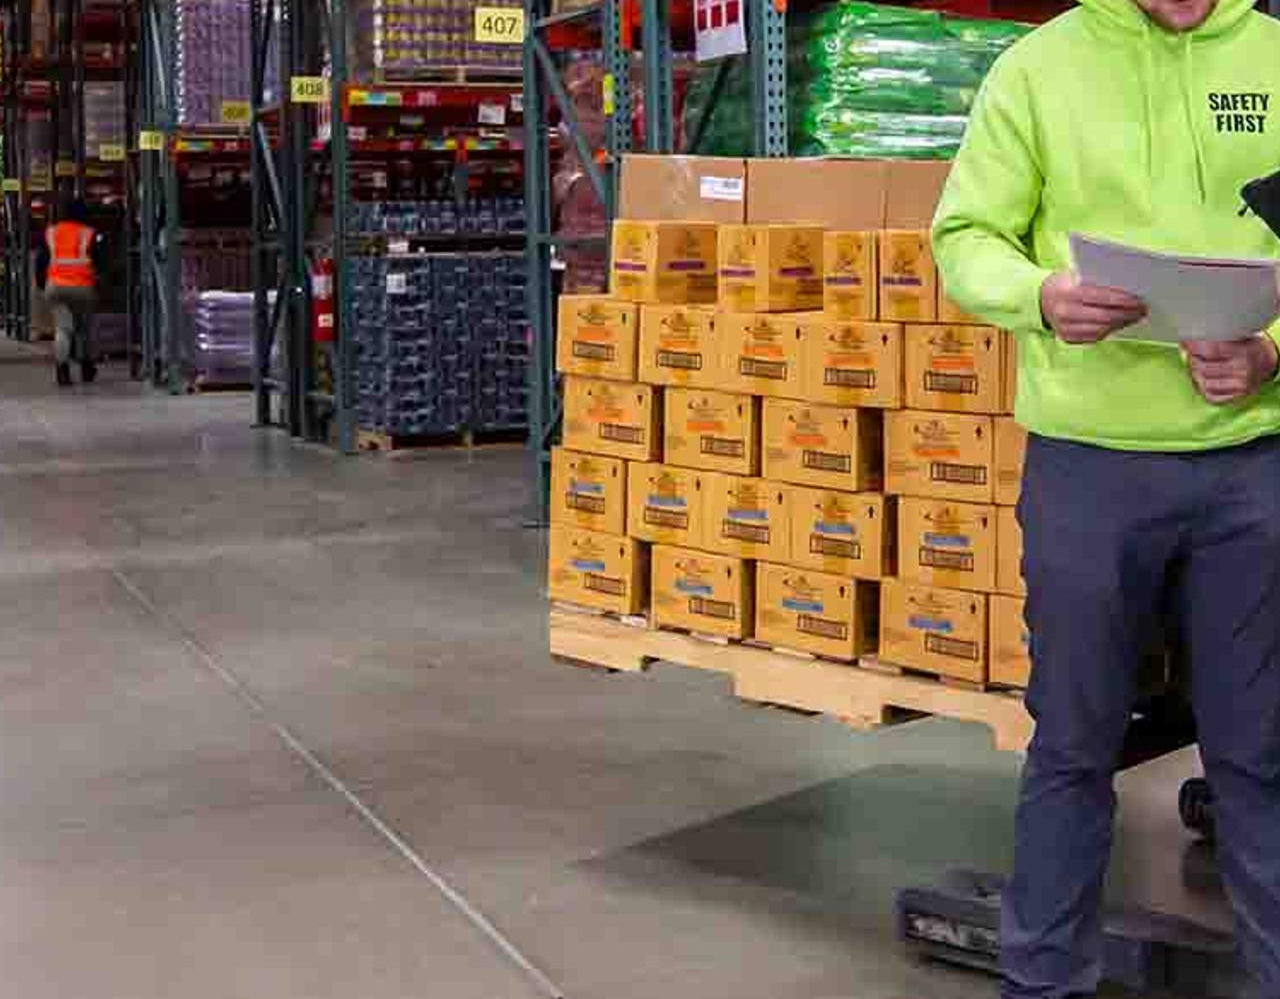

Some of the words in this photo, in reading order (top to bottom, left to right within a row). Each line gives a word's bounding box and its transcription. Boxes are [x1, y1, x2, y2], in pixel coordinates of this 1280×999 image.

[482, 16, 518, 35] 407
[1207, 92, 1270, 112] SAFETY
[1216, 113, 1266, 134] FIRST
